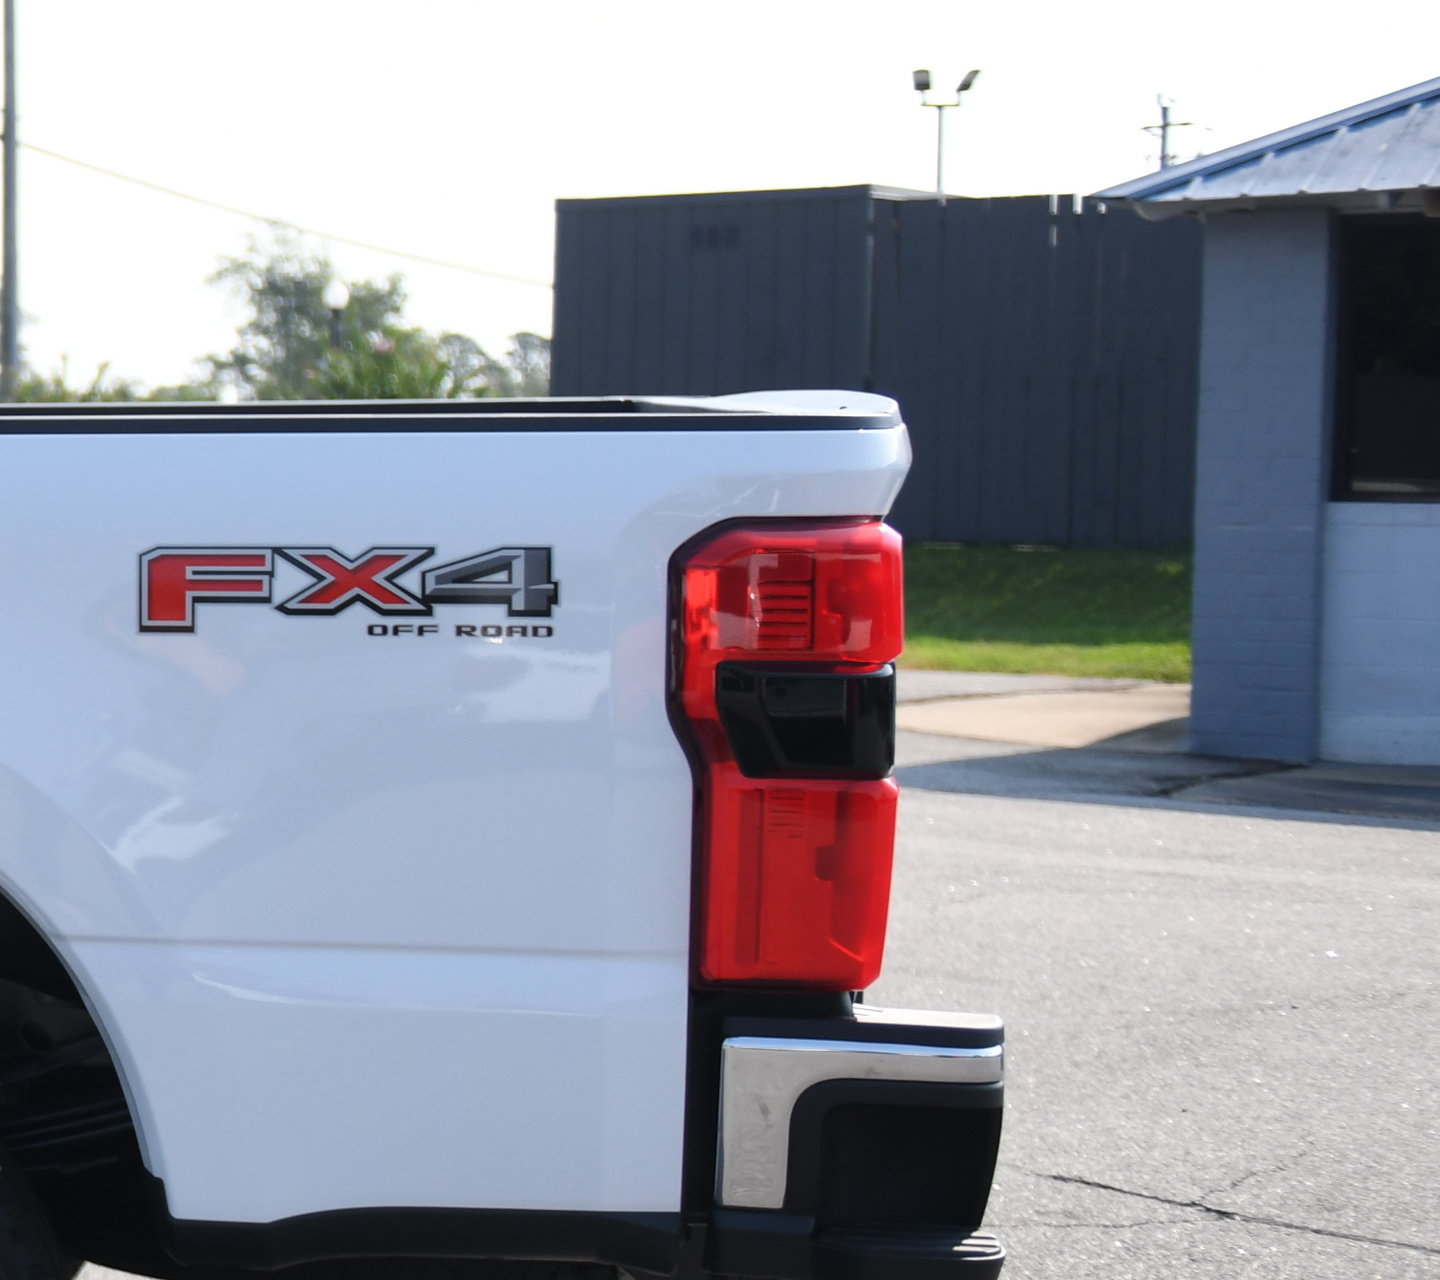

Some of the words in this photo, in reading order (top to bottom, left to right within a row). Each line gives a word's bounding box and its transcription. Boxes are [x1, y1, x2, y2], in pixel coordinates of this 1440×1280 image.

[138, 546, 559, 633] FX4
[367, 624, 439, 637] OFF
[455, 624, 554, 638] ROAD
